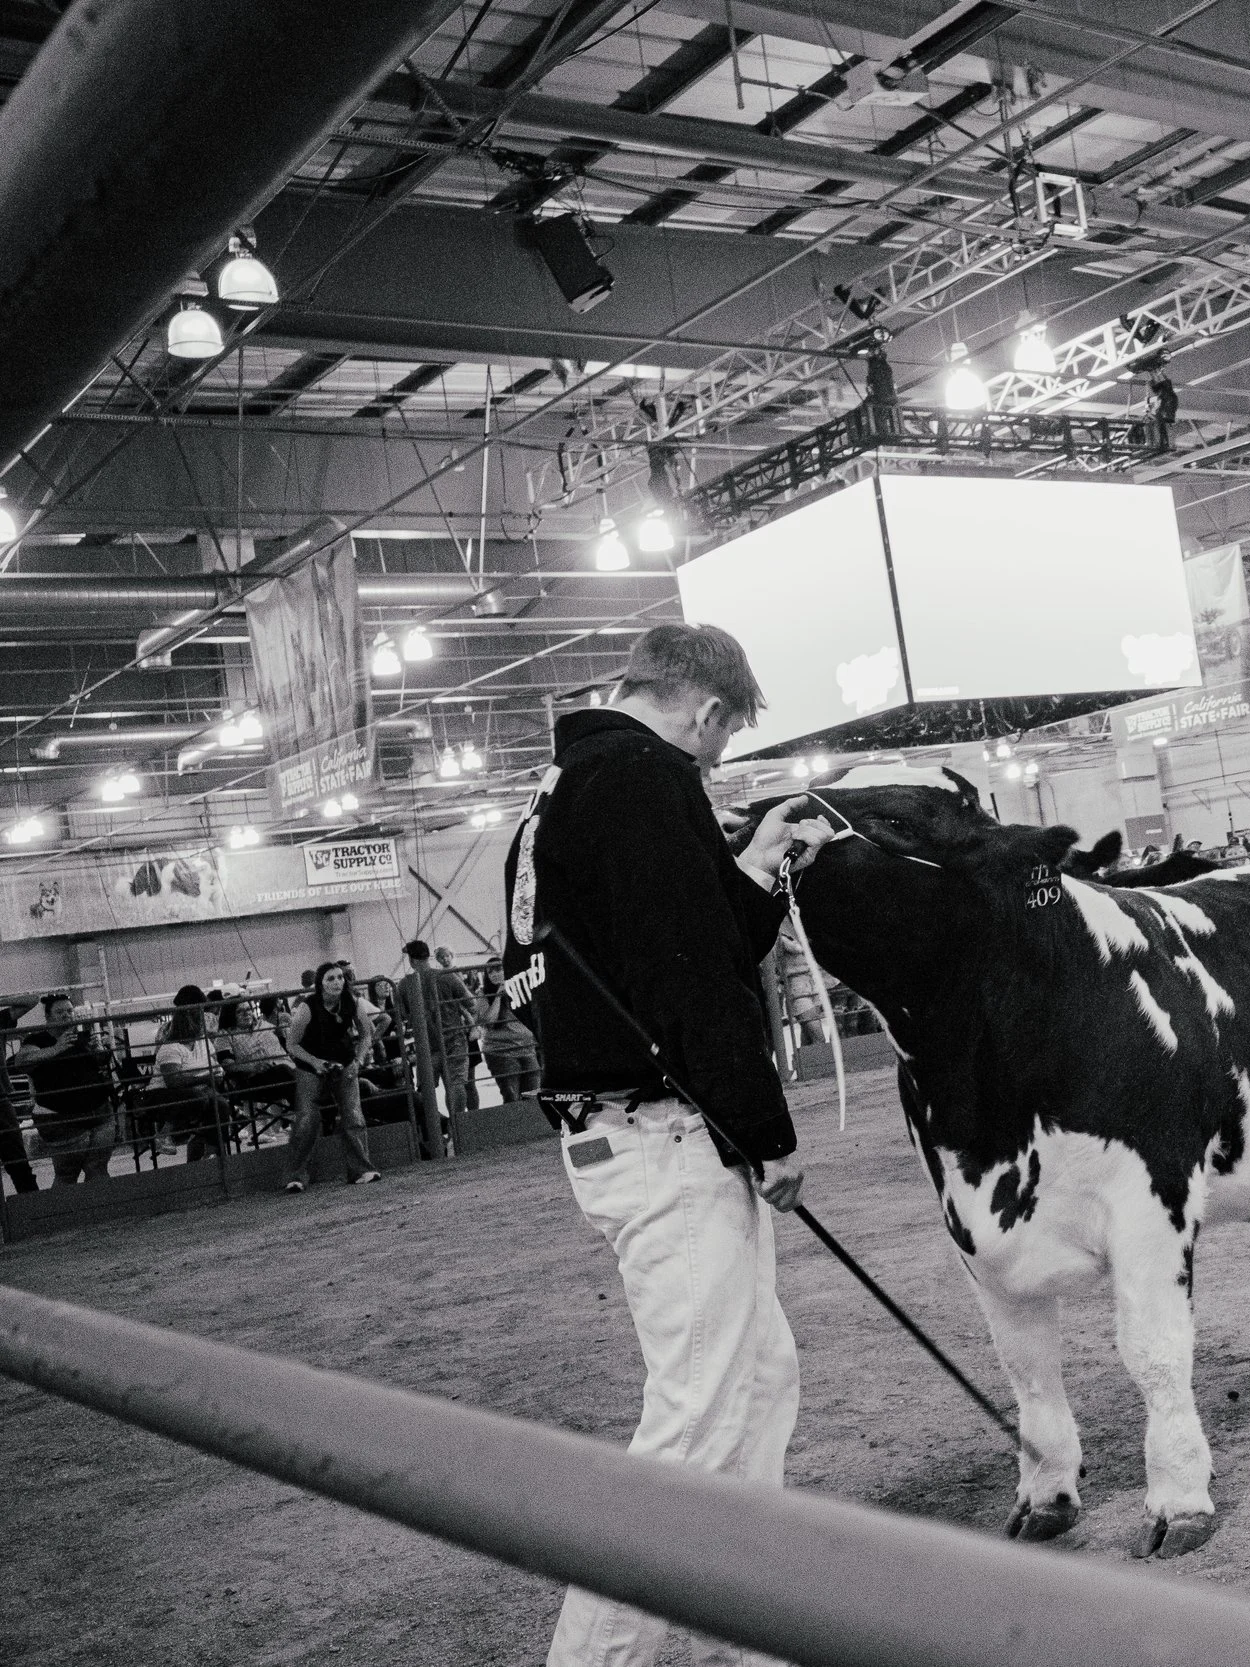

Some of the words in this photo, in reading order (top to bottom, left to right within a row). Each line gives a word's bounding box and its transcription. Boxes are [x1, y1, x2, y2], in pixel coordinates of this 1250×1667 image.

[1183, 691, 1243, 714] California
[1180, 710, 1216, 729] STATE
[1220, 702, 1250, 720] FAIR
[320, 769, 347, 794] STATE
[332, 843, 391, 858] TRACTOR
[333, 855, 377, 870] SUPPLY
[256, 888, 306, 902] FRIENDS
[308, 886, 322, 897] OF
[324, 884, 348, 895] LIFE
[350, 881, 372, 892] OUT
[373, 878, 401, 890] HERE
[1026, 886, 1061, 909] 409
[554, 1093, 584, 1102] SMART
